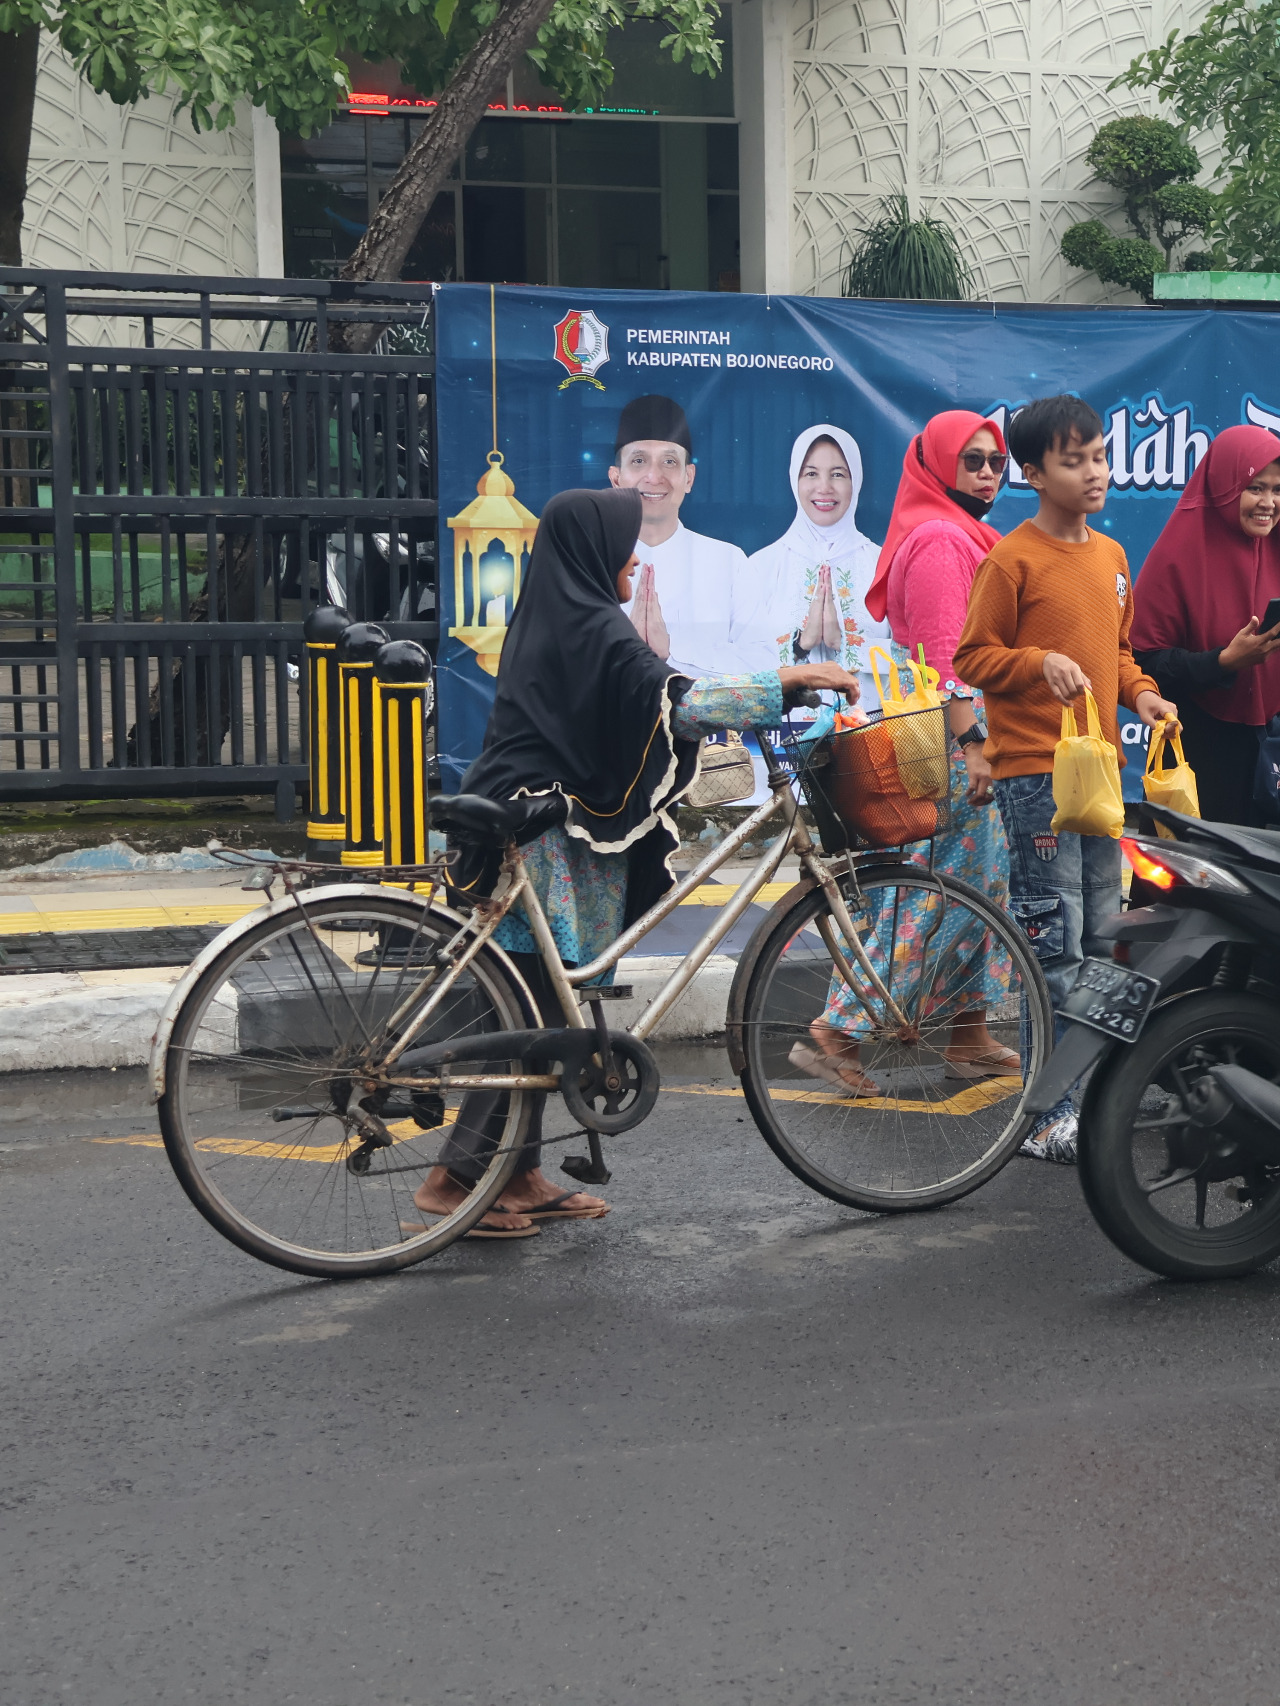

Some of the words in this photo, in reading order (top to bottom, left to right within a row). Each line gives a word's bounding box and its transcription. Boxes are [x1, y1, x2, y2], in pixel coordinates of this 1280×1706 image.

[626, 328, 731, 346] PEMERINTAH
[626, 351, 721, 368] KABUPATEN
[726, 353, 834, 371] BOJONEGORO
[1034, 838, 1056, 847] BRONX
